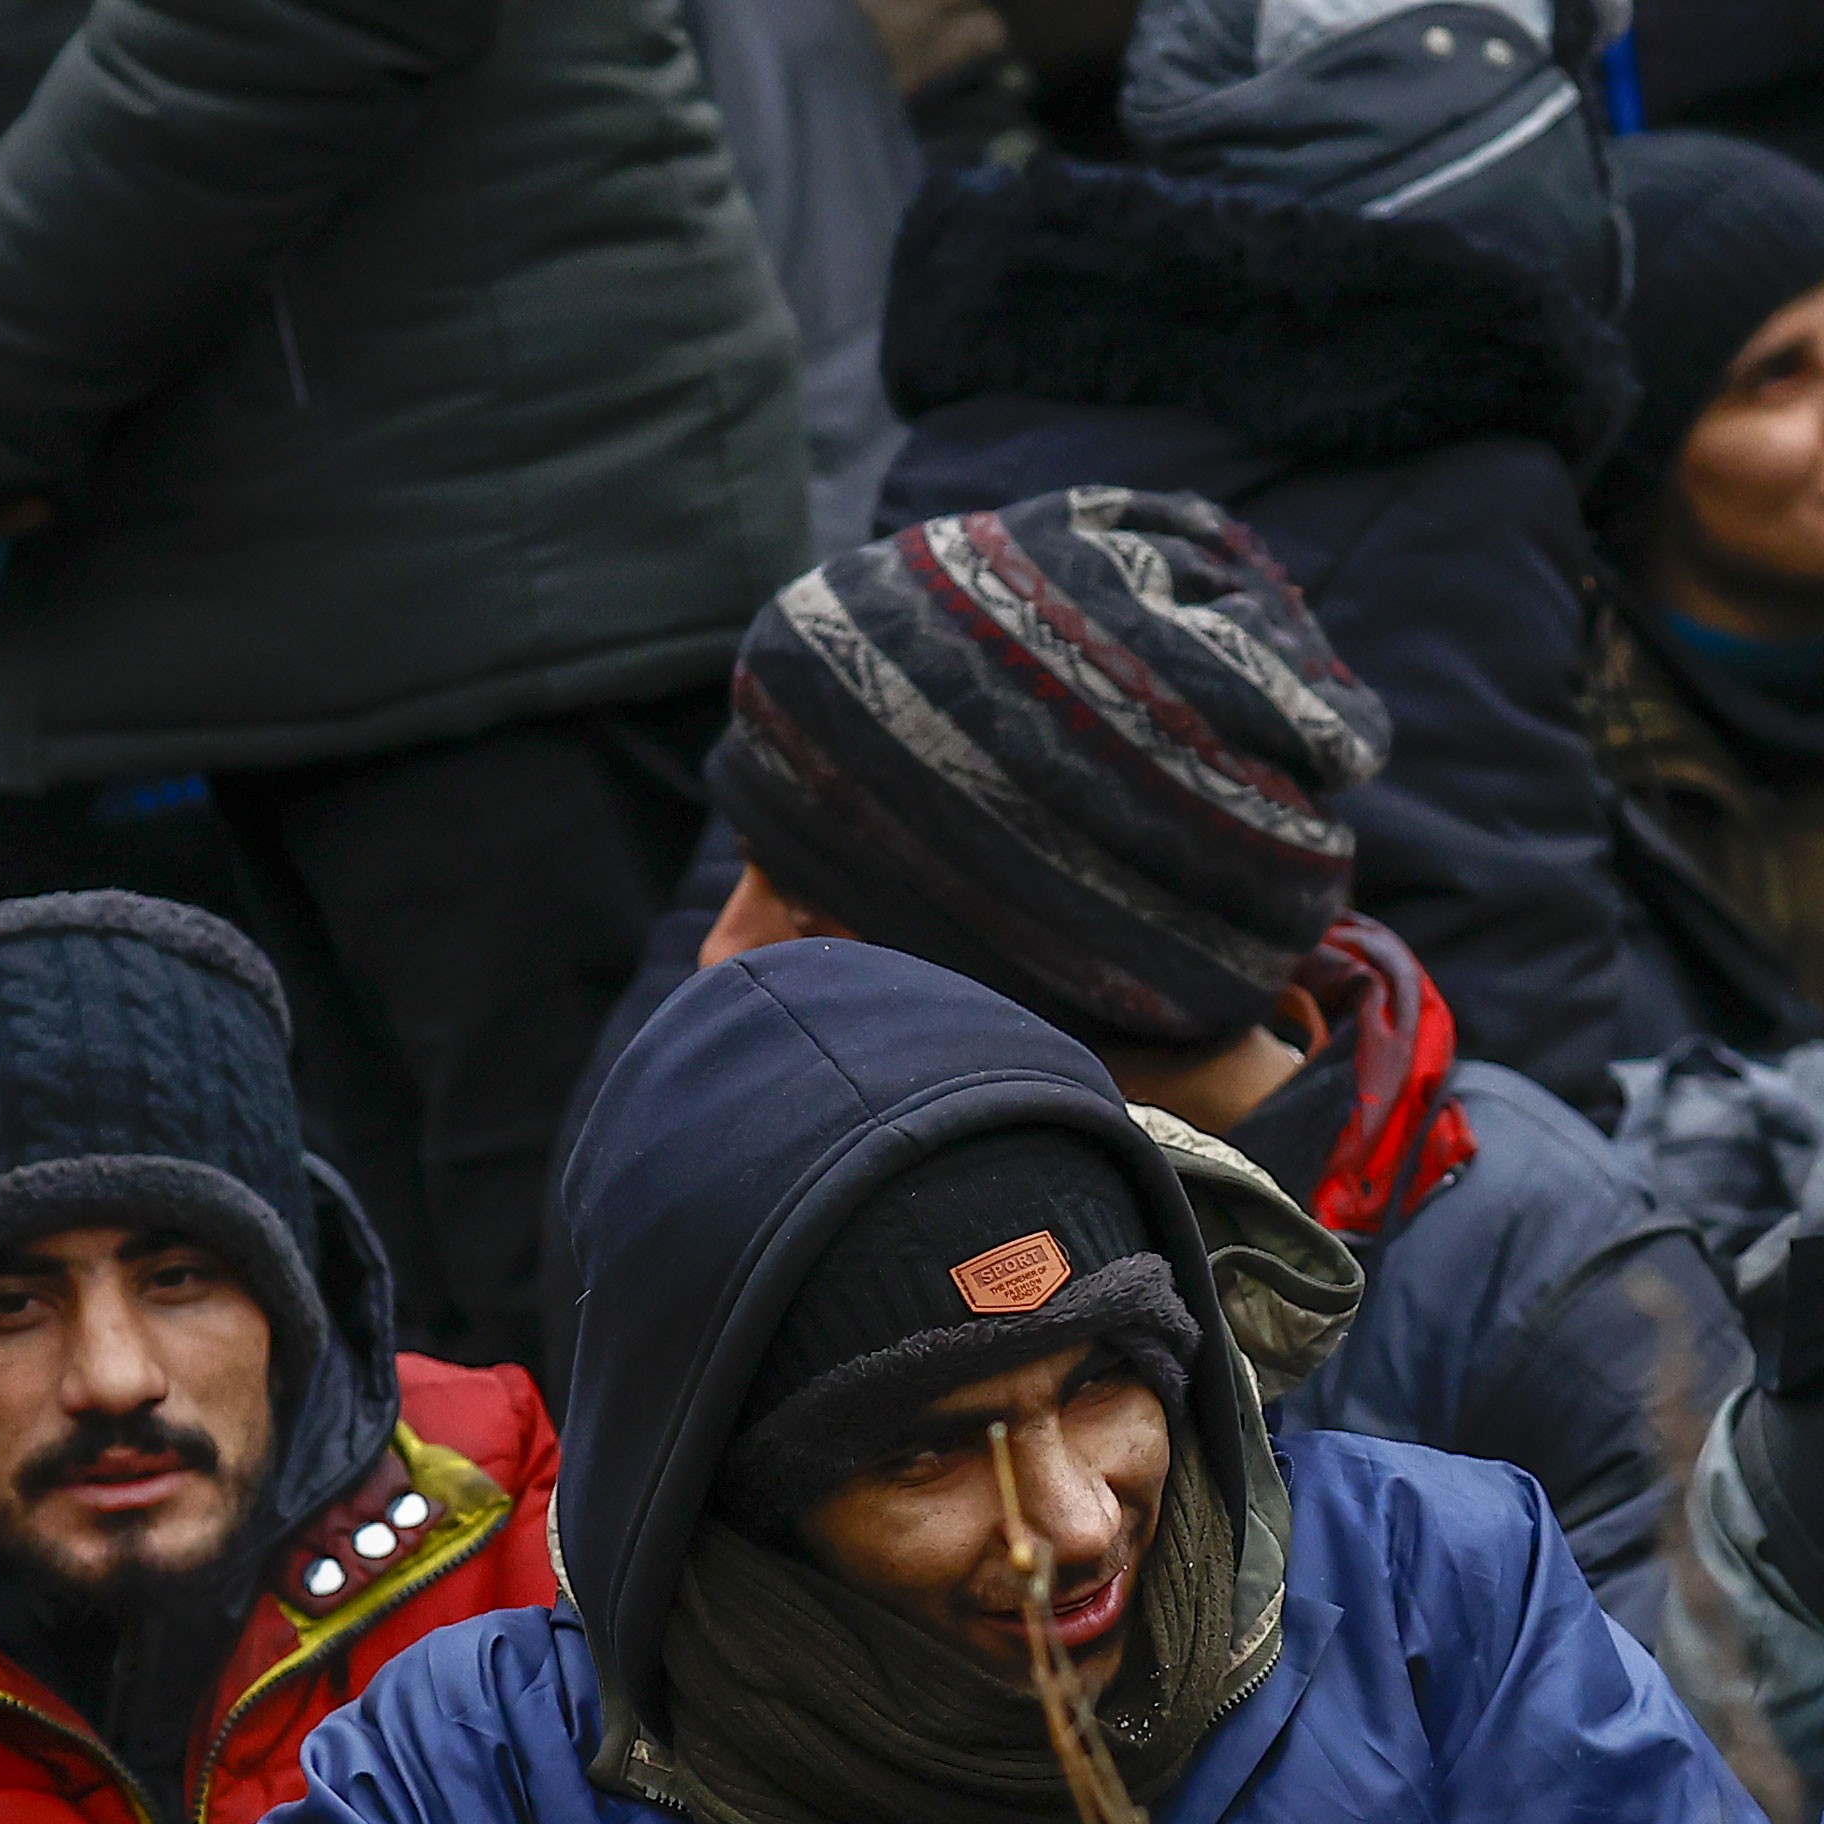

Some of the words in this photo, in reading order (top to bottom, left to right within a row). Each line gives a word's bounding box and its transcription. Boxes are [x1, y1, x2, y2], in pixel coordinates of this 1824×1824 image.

[980, 1250, 1039, 1284] SPORT
[989, 1283, 1005, 1295] THE
[1003, 1278, 1043, 1298] FASHION
